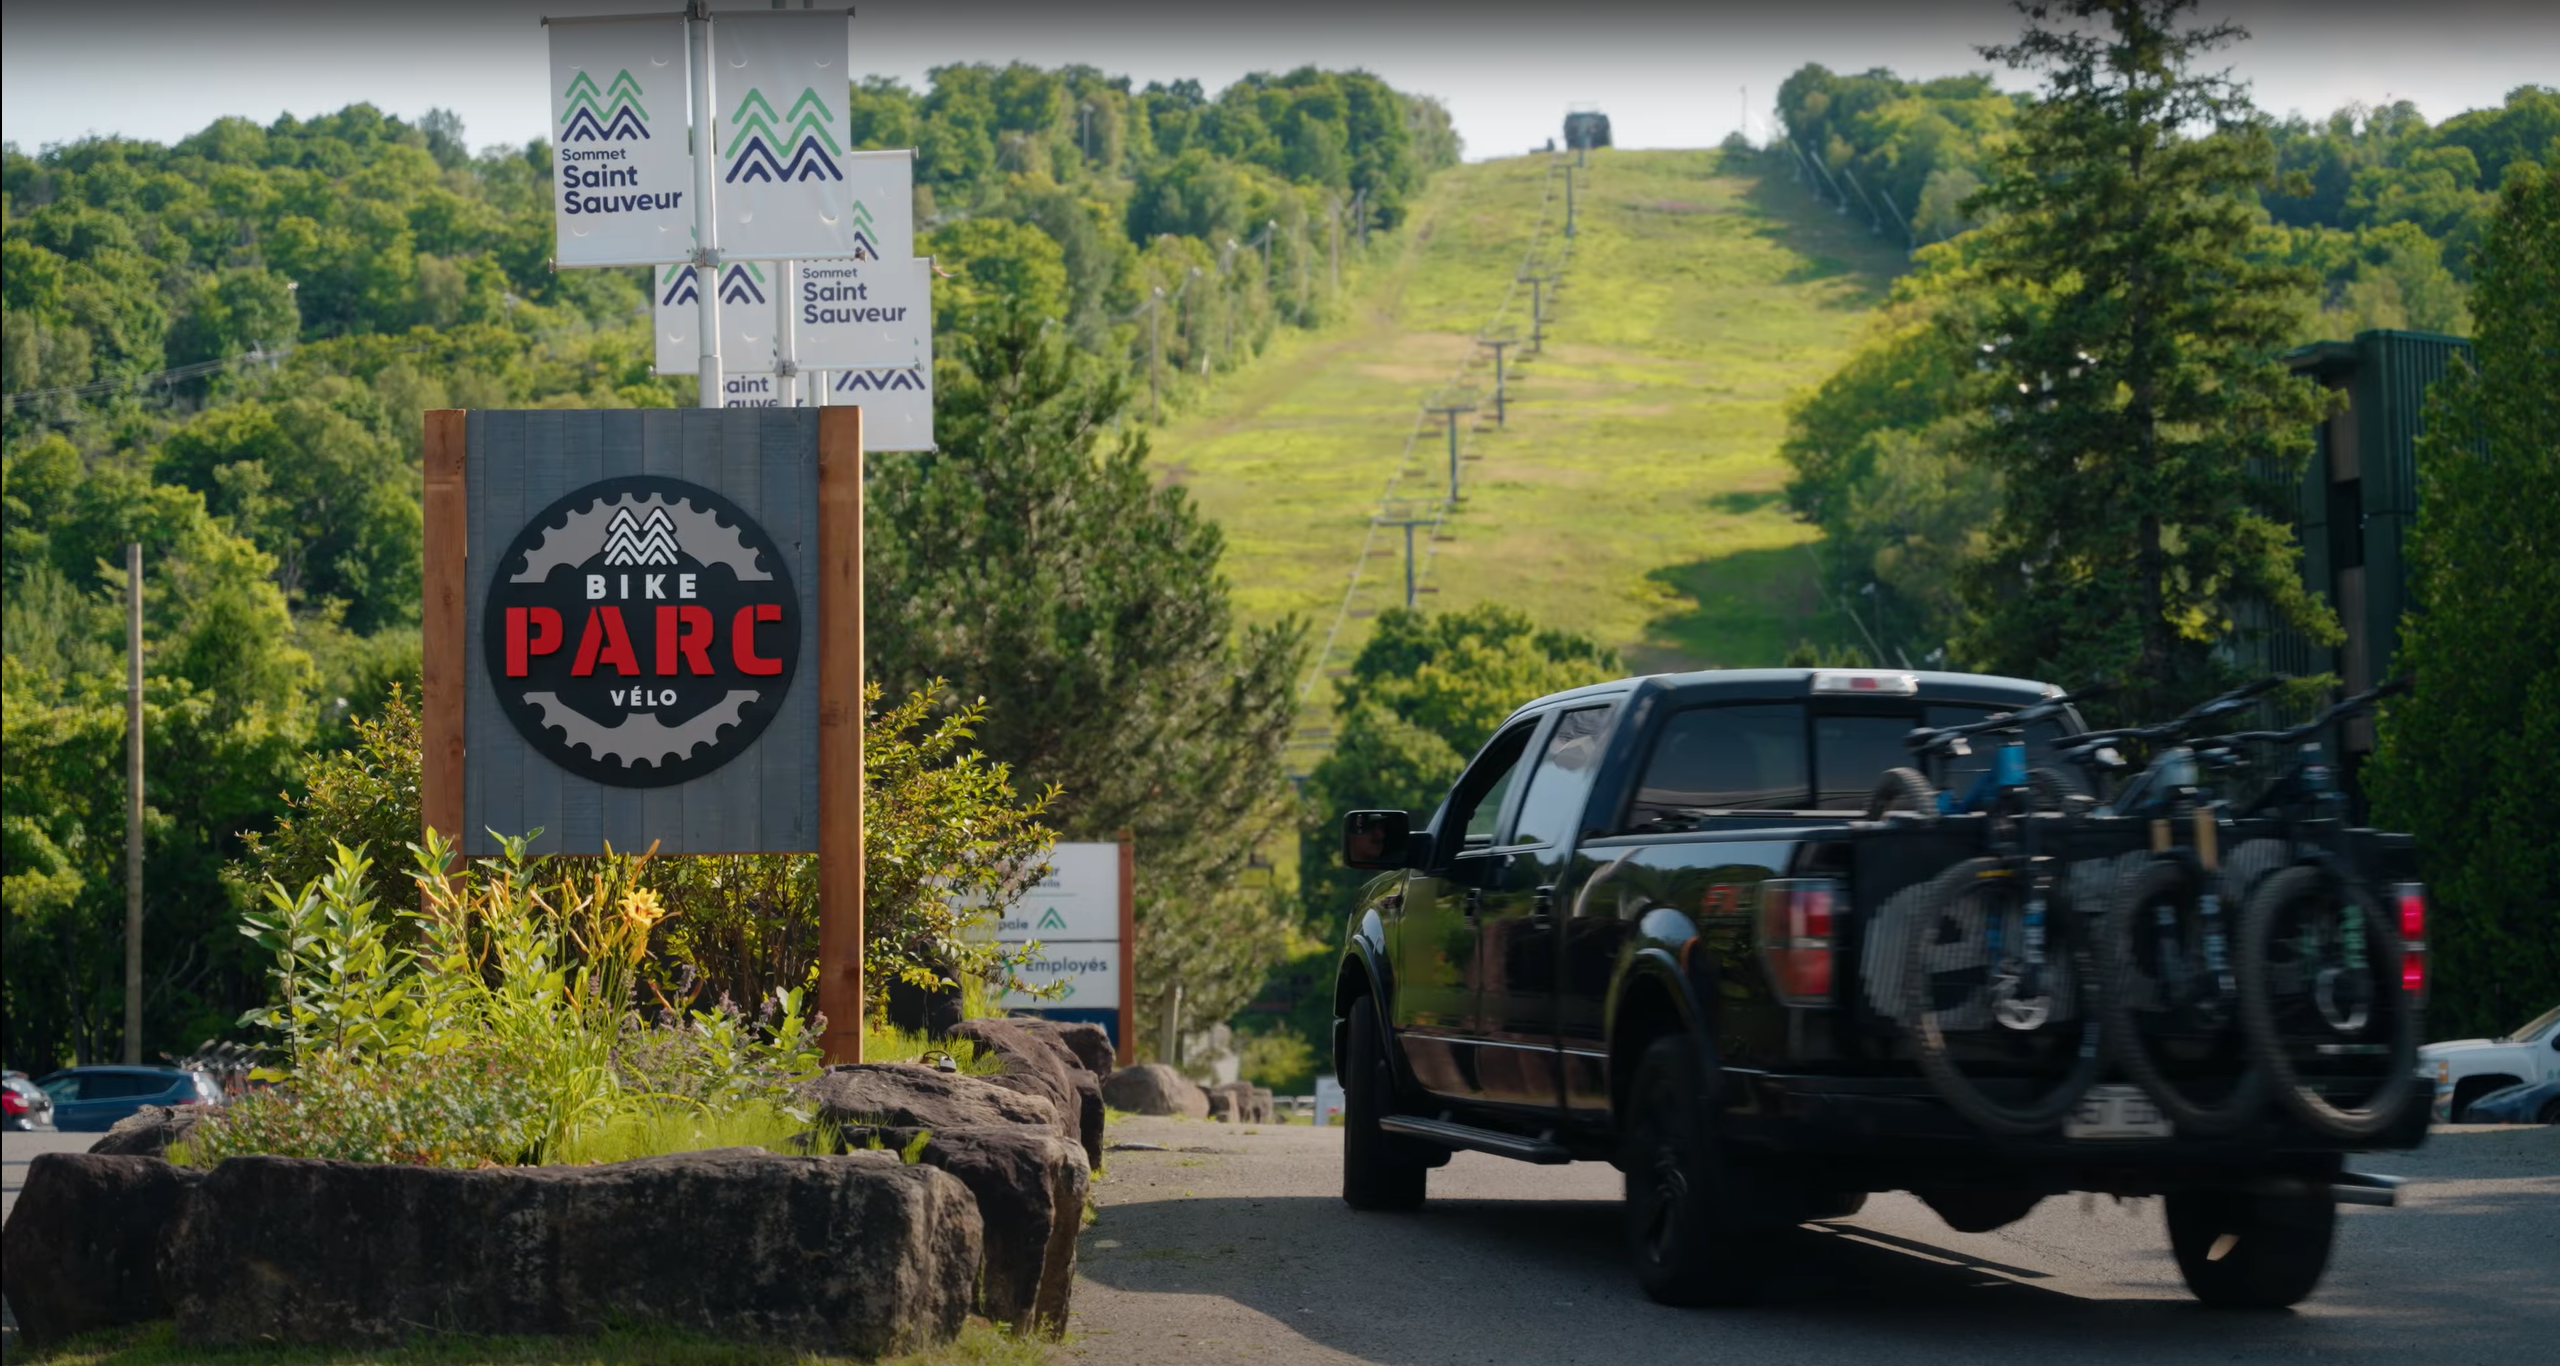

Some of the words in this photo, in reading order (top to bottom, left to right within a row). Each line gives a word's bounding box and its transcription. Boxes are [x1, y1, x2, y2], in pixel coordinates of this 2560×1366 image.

[562, 148, 626, 161] Sommet
[563, 164, 638, 189] Saint
[564, 191, 682, 214] Sauveur
[803, 268, 858, 279] Sommet
[803, 281, 867, 302] Saint
[804, 304, 906, 324] Sauveur
[723, 375, 769, 393] aint
[586, 573, 697, 600] BIKE
[506, 604, 783, 677] PARC
[610, 685, 677, 706] VÉLO
[1025, 957, 1107, 974] Employés
